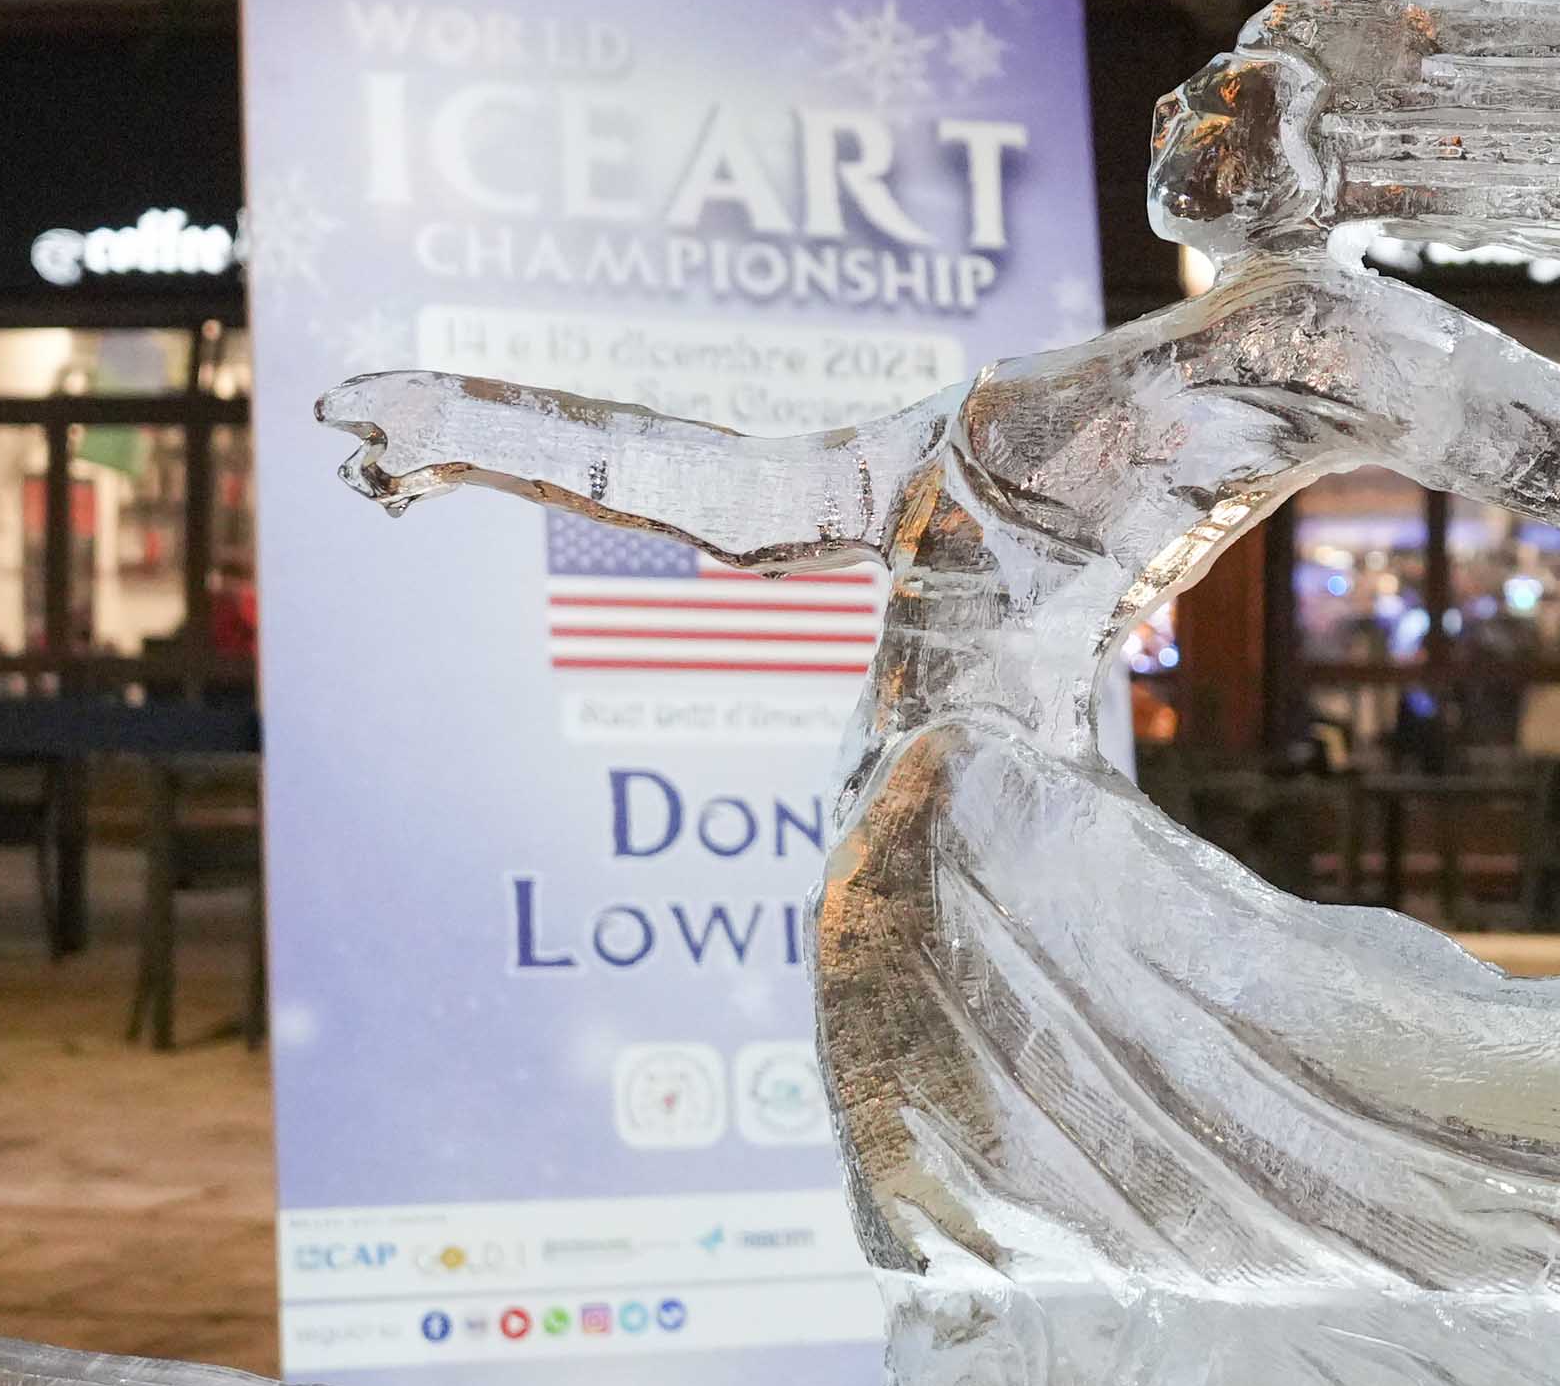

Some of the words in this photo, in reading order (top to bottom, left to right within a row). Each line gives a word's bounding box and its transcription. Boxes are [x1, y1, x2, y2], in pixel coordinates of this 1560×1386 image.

[342, 0, 630, 71] WORLD
[413, 225, 997, 309] CHAMPIONSHIP
[445, 315, 487, 357] 14
[609, 324, 808, 377] dicembre
[824, 338, 939, 381] 2024
[514, 877, 803, 968] LOWI
[326, 1242, 398, 1270] CAP
